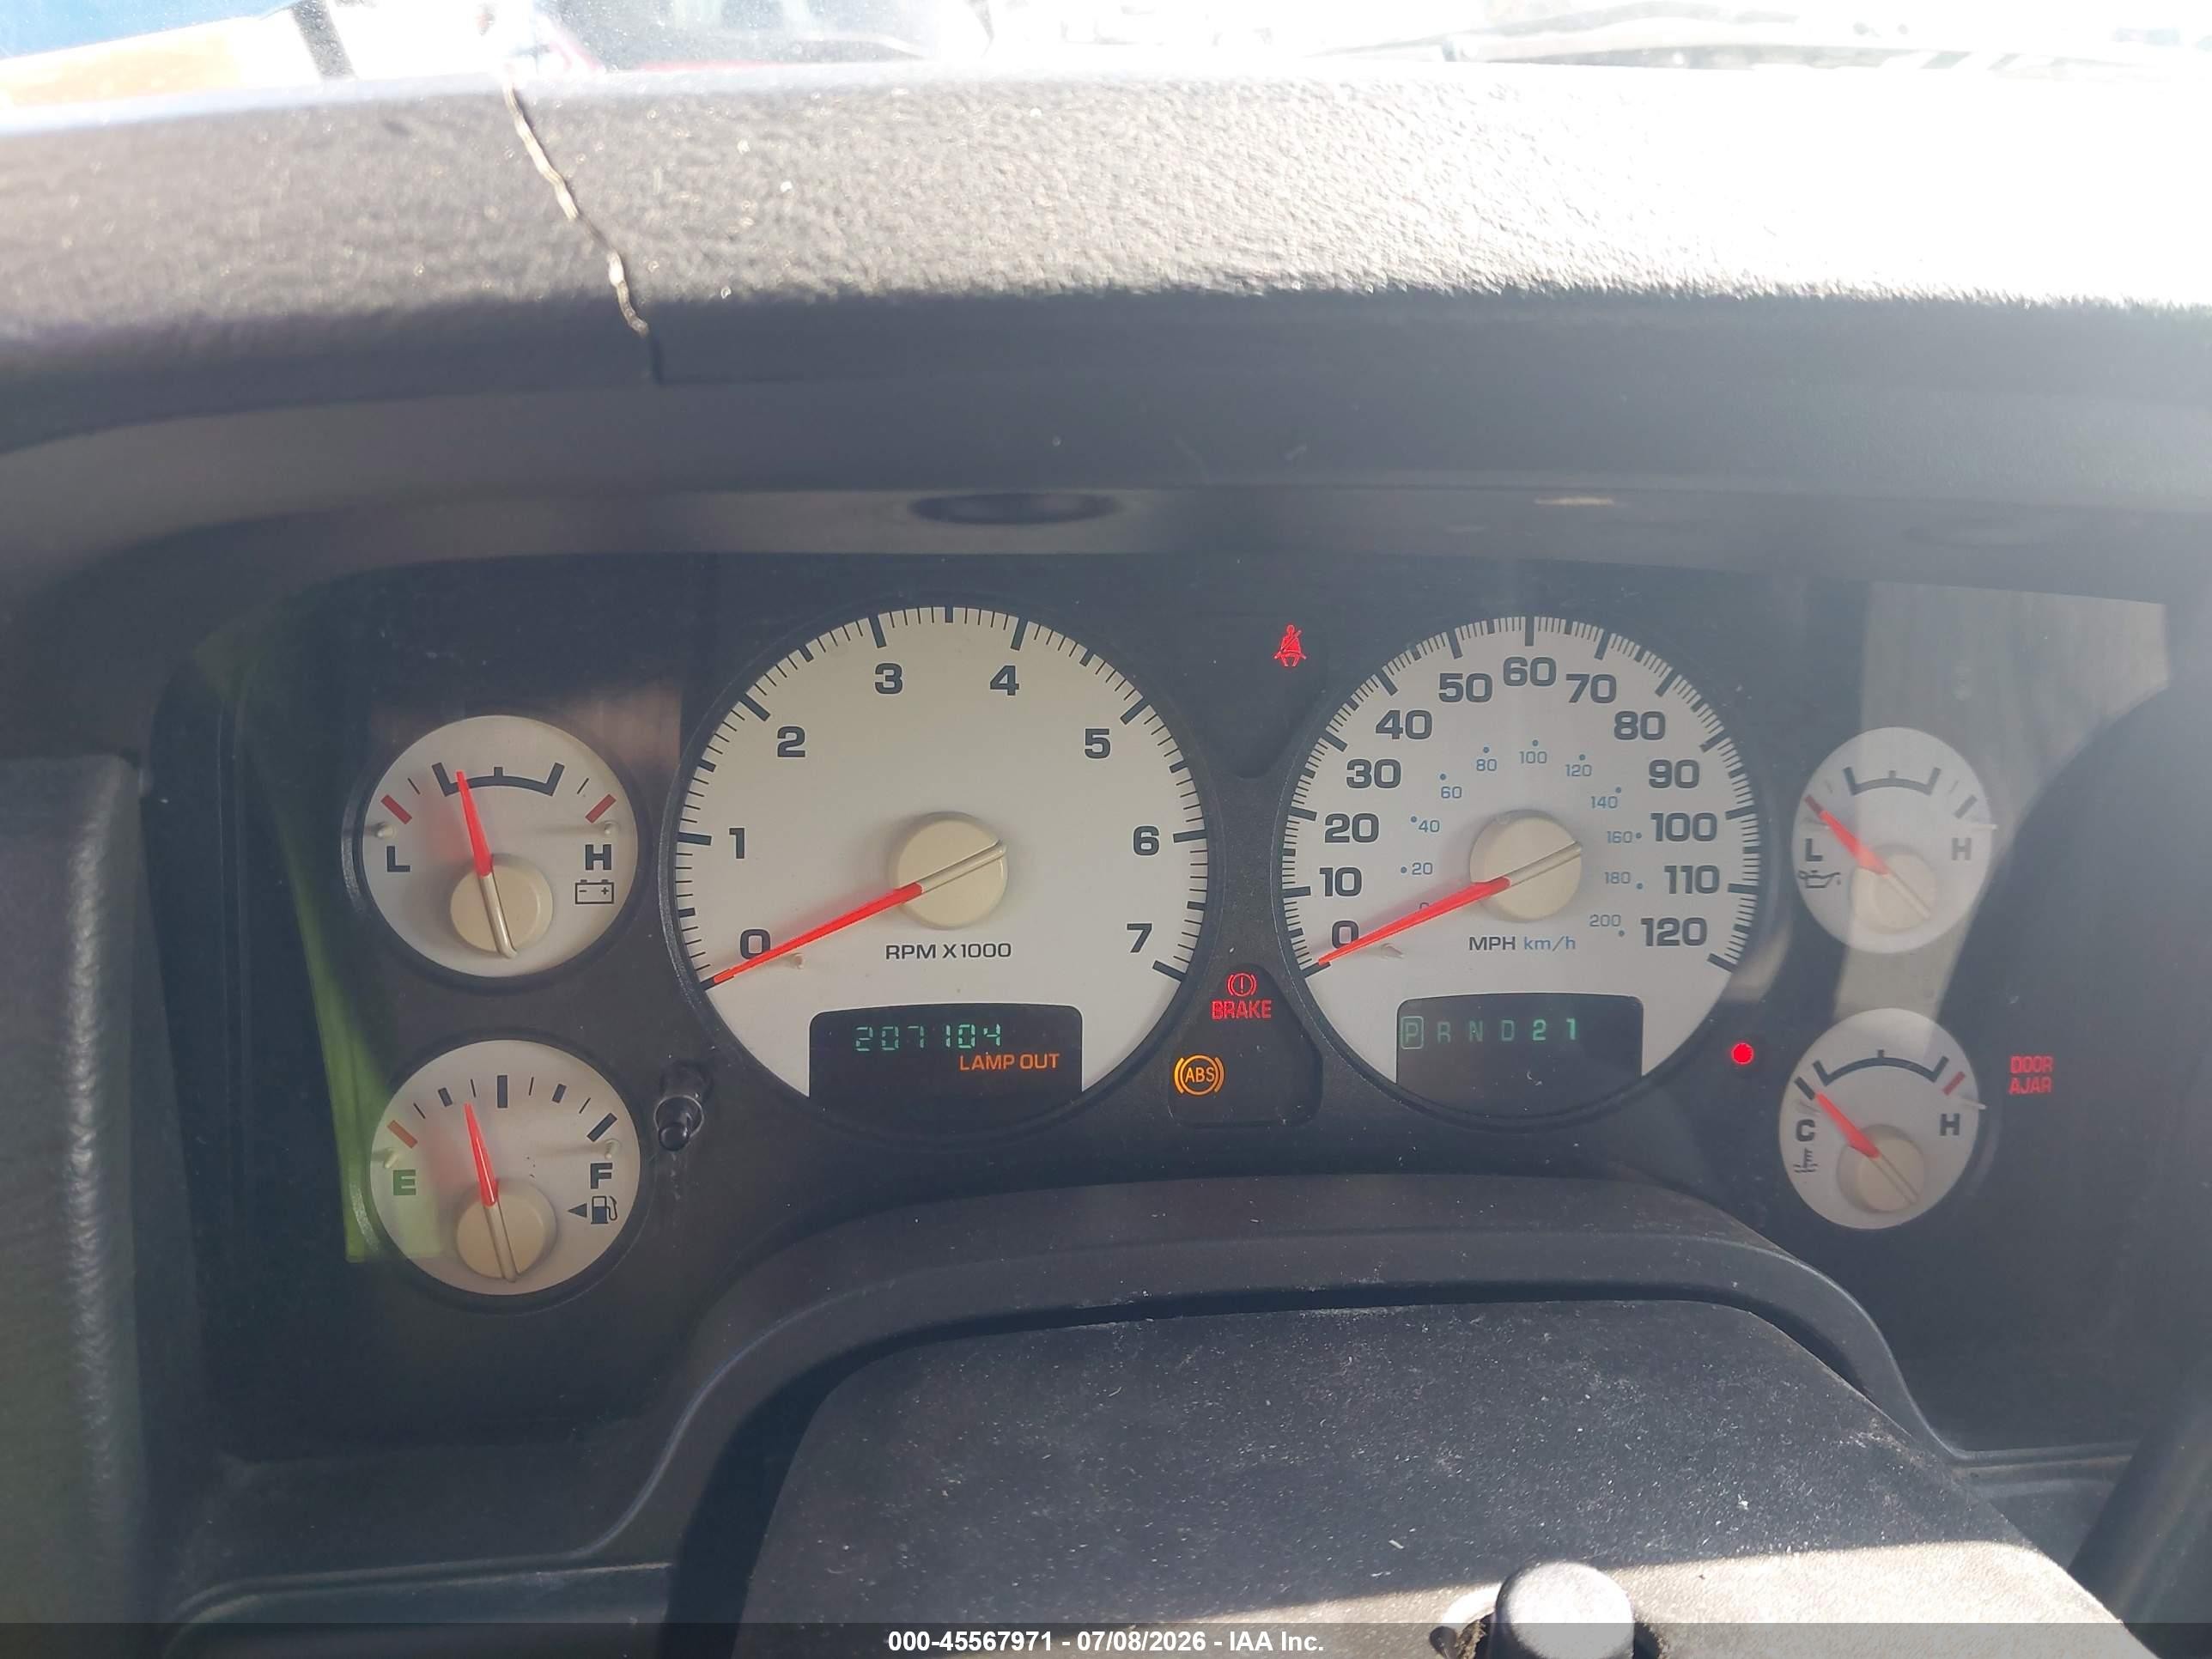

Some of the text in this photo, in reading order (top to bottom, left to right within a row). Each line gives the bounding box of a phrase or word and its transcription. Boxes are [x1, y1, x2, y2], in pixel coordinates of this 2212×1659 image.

[874, 662, 903, 695] 3
[990, 665, 1019, 696] 4
[1503, 656, 1557, 686] 60
[1438, 672, 1492, 703] 50
[1565, 673, 1617, 703] 70
[1376, 710, 1432, 740] 40
[1613, 711, 1666, 740] 80
[776, 726, 805, 758] 2
[1084, 728, 1111, 759] 5
[1476, 758, 1497, 772] 80
[1519, 750, 1547, 764] 100
[1346, 758, 1401, 788] 30
[1565, 764, 1592, 778] 120
[1648, 759, 1699, 789] 90
[1440, 786, 1462, 799] 60
[1590, 796, 1618, 809] 140
[1324, 813, 1379, 843] 20
[1419, 820, 1440, 833] 40
[1607, 830, 1632, 844] 160
[1650, 812, 1717, 842] 100
[729, 828, 746, 859] 1
[1133, 825, 1159, 855] 6
[1806, 838, 1823, 862] L
[1952, 837, 1972, 860] H
[386, 846, 410, 872] L
[585, 844, 611, 871] H
[1412, 862, 1433, 876] 20
[1319, 867, 1362, 896] 10
[1605, 872, 1631, 885] 180
[1664, 865, 1719, 894] 110
[1589, 914, 1621, 927] 200
[1641, 917, 1707, 946] 120
[739, 928, 771, 959] 0
[1127, 923, 1153, 953] 7
[1332, 921, 1359, 949] 0
[1469, 936, 1576, 951] MPH km/h
[885, 945, 938, 960] RPM
[1212, 1000, 1272, 1019] BRAKE
[855, 1024, 1001, 1051] 207104
[1405, 1018, 1576, 1043] P R N D 2 1
[959, 1053, 1060, 1071] LAMP OUT
[1185, 1066, 1215, 1083] ABS
[2009, 1055, 2054, 1073] DOOR
[2008, 1077, 2052, 1095] AJAR
[1796, 1119, 1815, 1142] C
[1940, 1113, 1960, 1136] H
[392, 1169, 416, 1195] E
[590, 1163, 613, 1188] F
